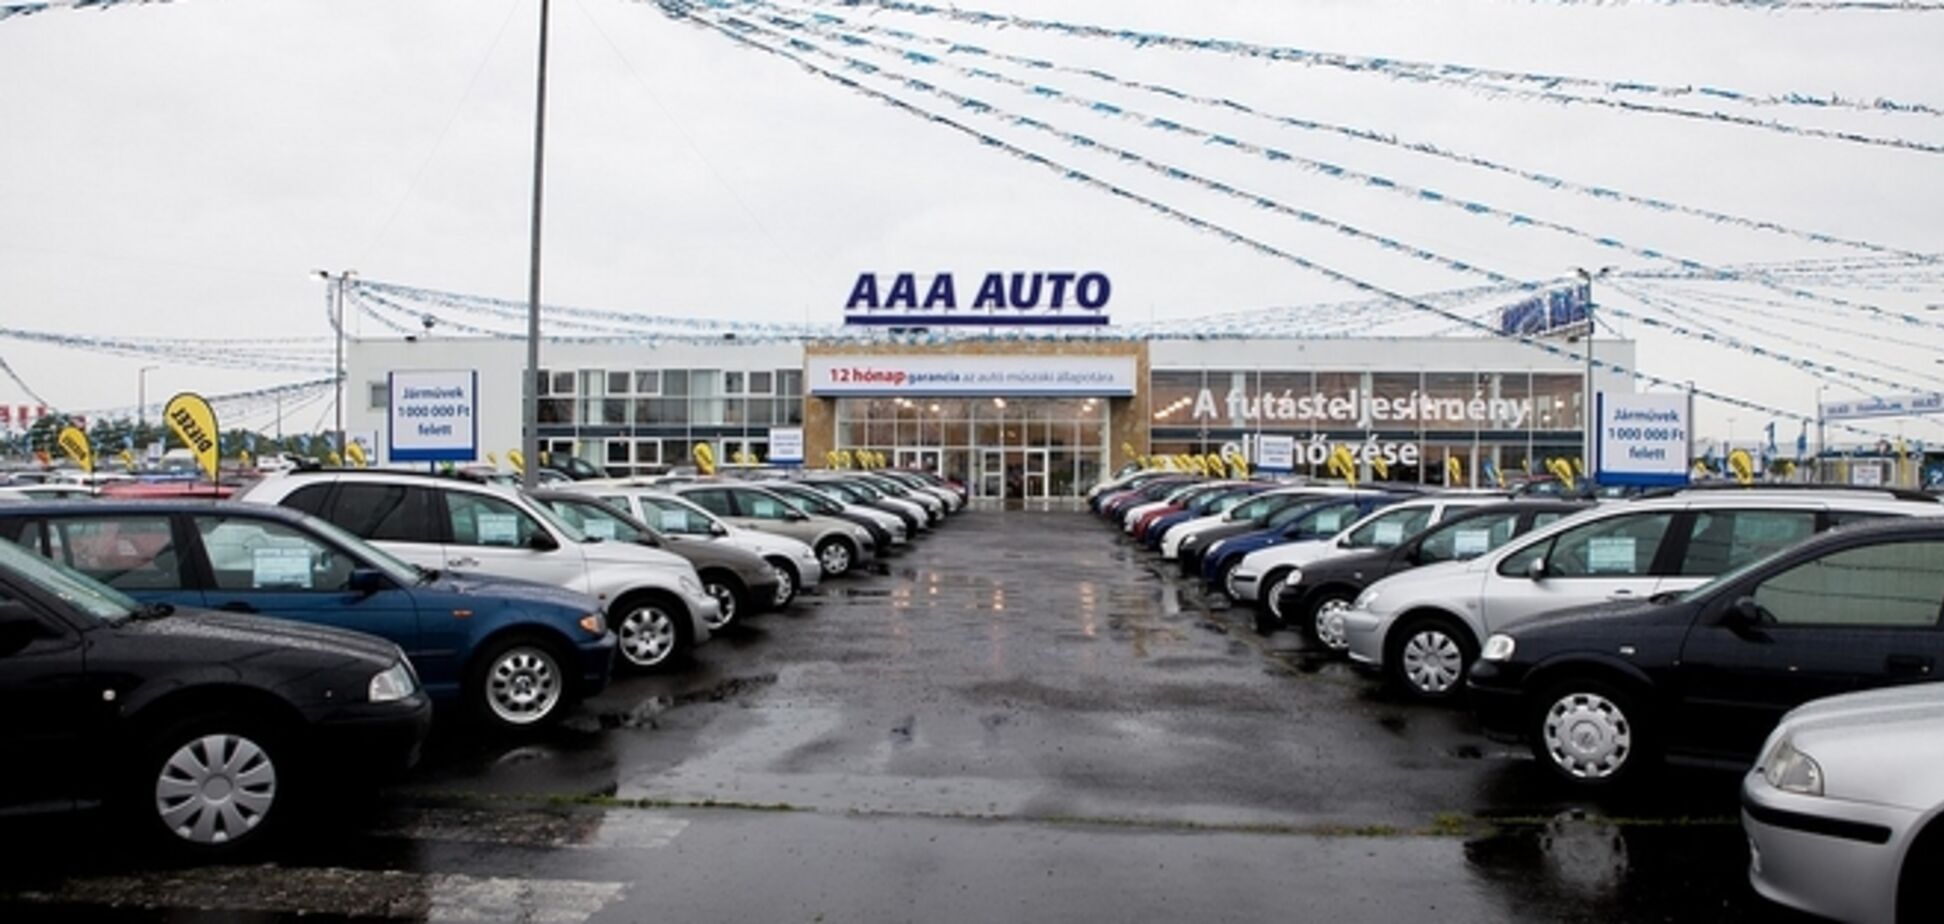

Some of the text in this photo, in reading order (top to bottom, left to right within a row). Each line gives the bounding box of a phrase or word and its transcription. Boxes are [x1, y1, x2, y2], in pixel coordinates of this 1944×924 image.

[845, 271, 1111, 311] AAA AUTO
[831, 368, 850, 383] 12
[853, 368, 905, 386] hónap
[908, 371, 961, 385] garancia
[407, 405, 429, 417] 000
[430, 404, 455, 417] 000
[457, 404, 470, 417] Ft
[1193, 388, 1529, 429] A futásteljesítmény
[418, 423, 452, 436] felett
[1617, 427, 1642, 440] 000
[1643, 427, 1669, 440] 000
[1628, 445, 1665, 460] felett
